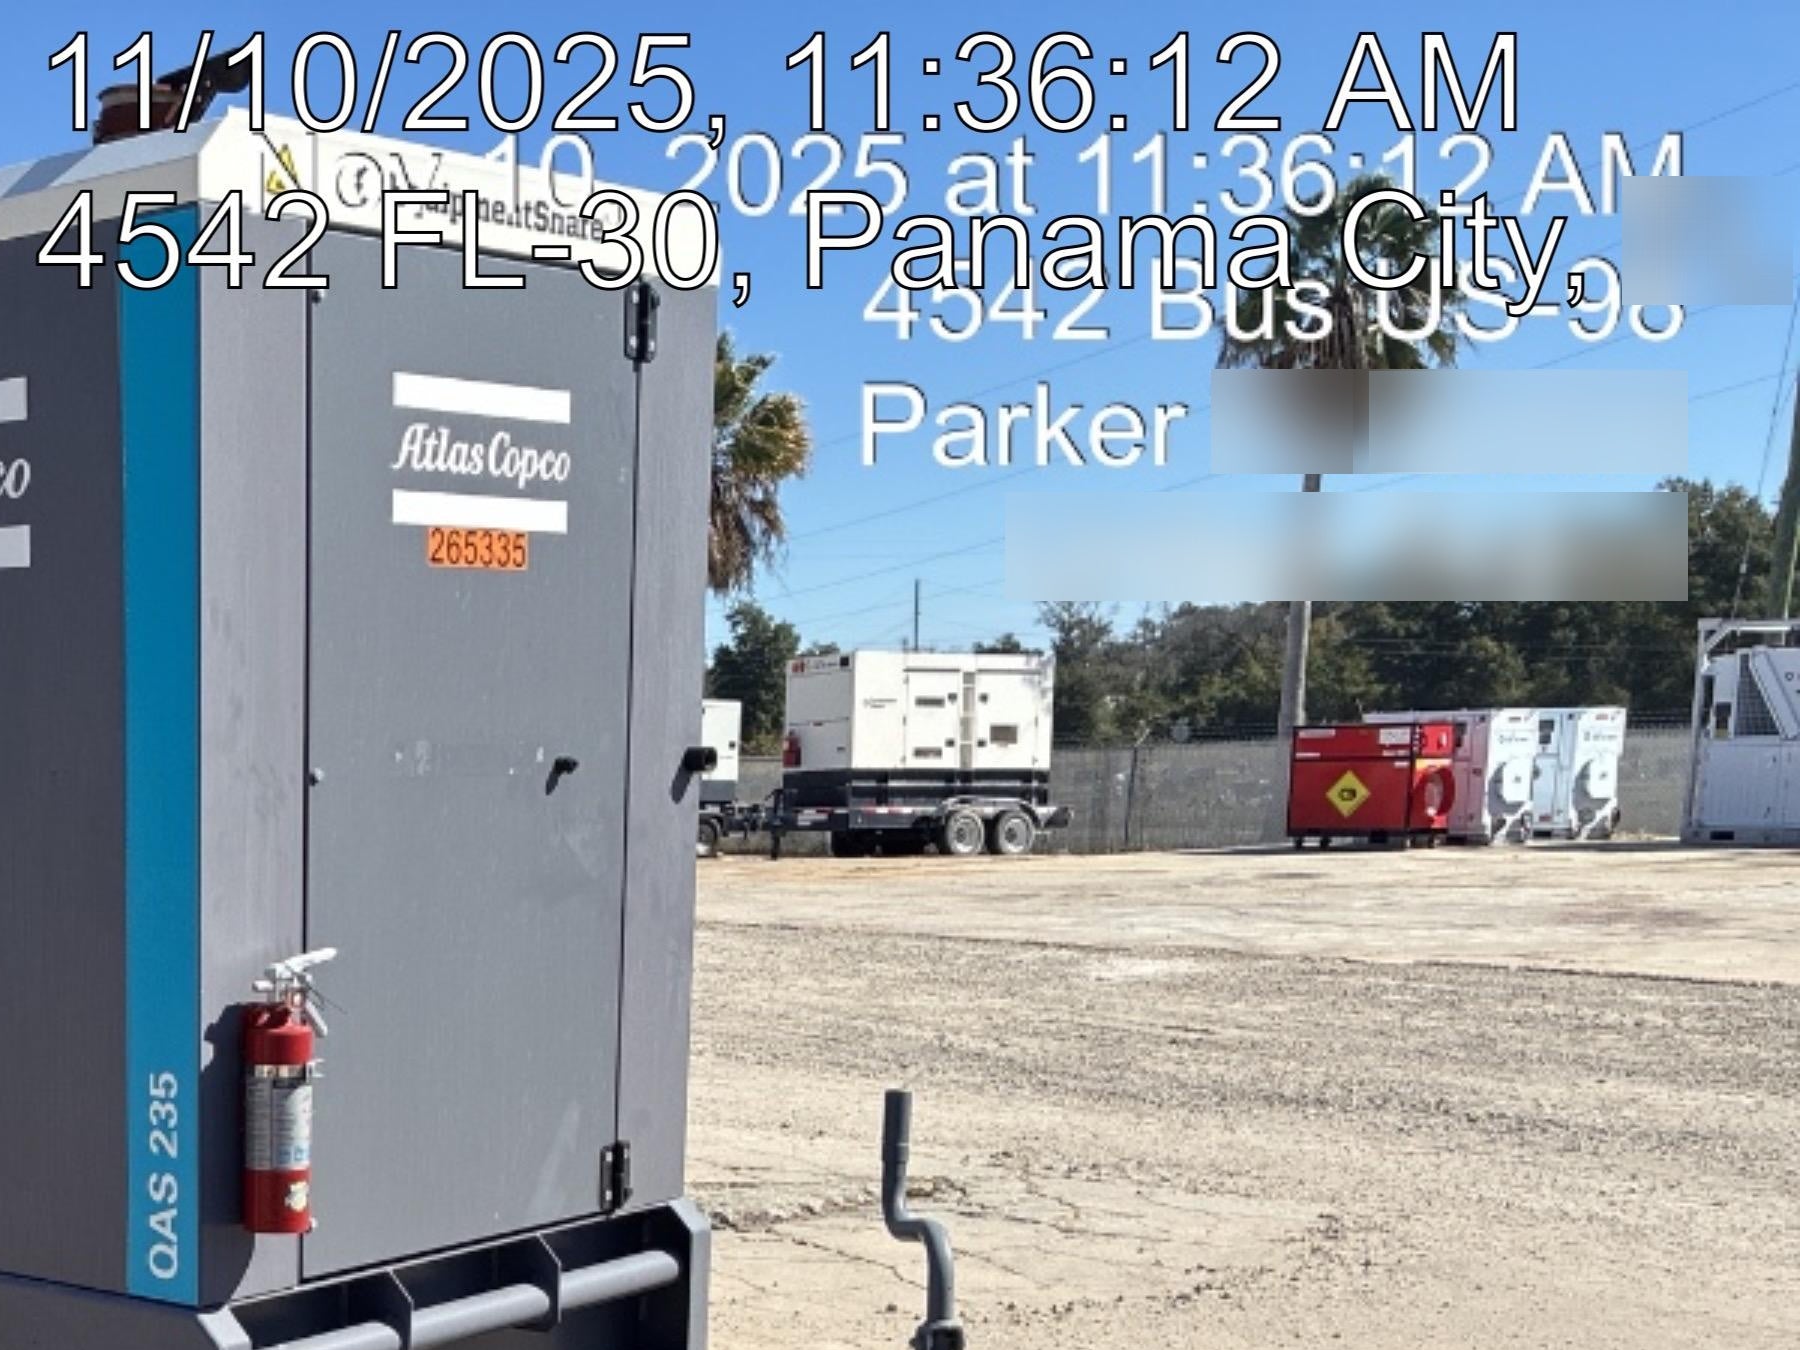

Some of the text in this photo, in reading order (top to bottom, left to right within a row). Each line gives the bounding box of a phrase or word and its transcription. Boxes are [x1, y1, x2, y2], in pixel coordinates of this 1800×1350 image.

[390, 422, 571, 490] Atlas Copco
[429, 527, 526, 568] 265335
[149, 1070, 178, 1280] QAS 235
